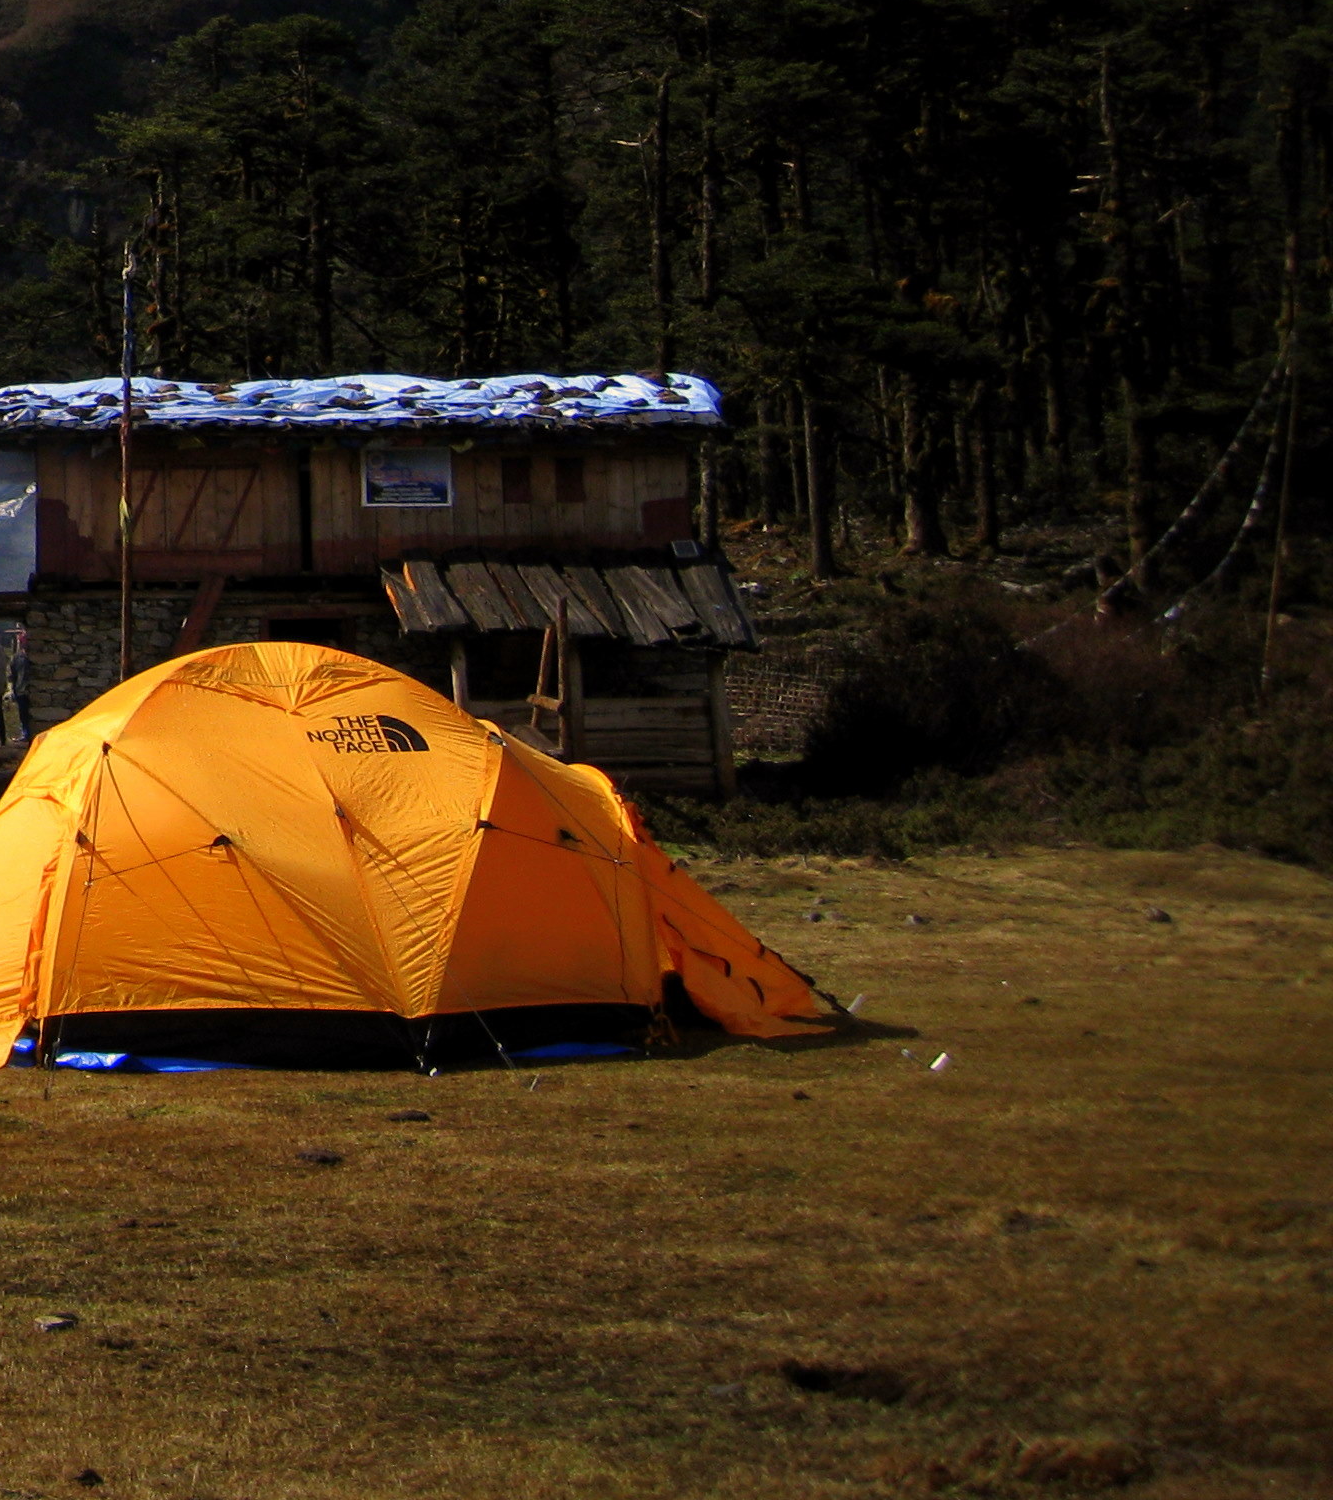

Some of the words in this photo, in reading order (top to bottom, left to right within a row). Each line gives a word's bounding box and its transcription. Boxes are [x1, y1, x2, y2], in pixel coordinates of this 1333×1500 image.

[331, 714, 377, 729] THE
[306, 728, 382, 743] NORTH
[333, 740, 388, 754] FACE
